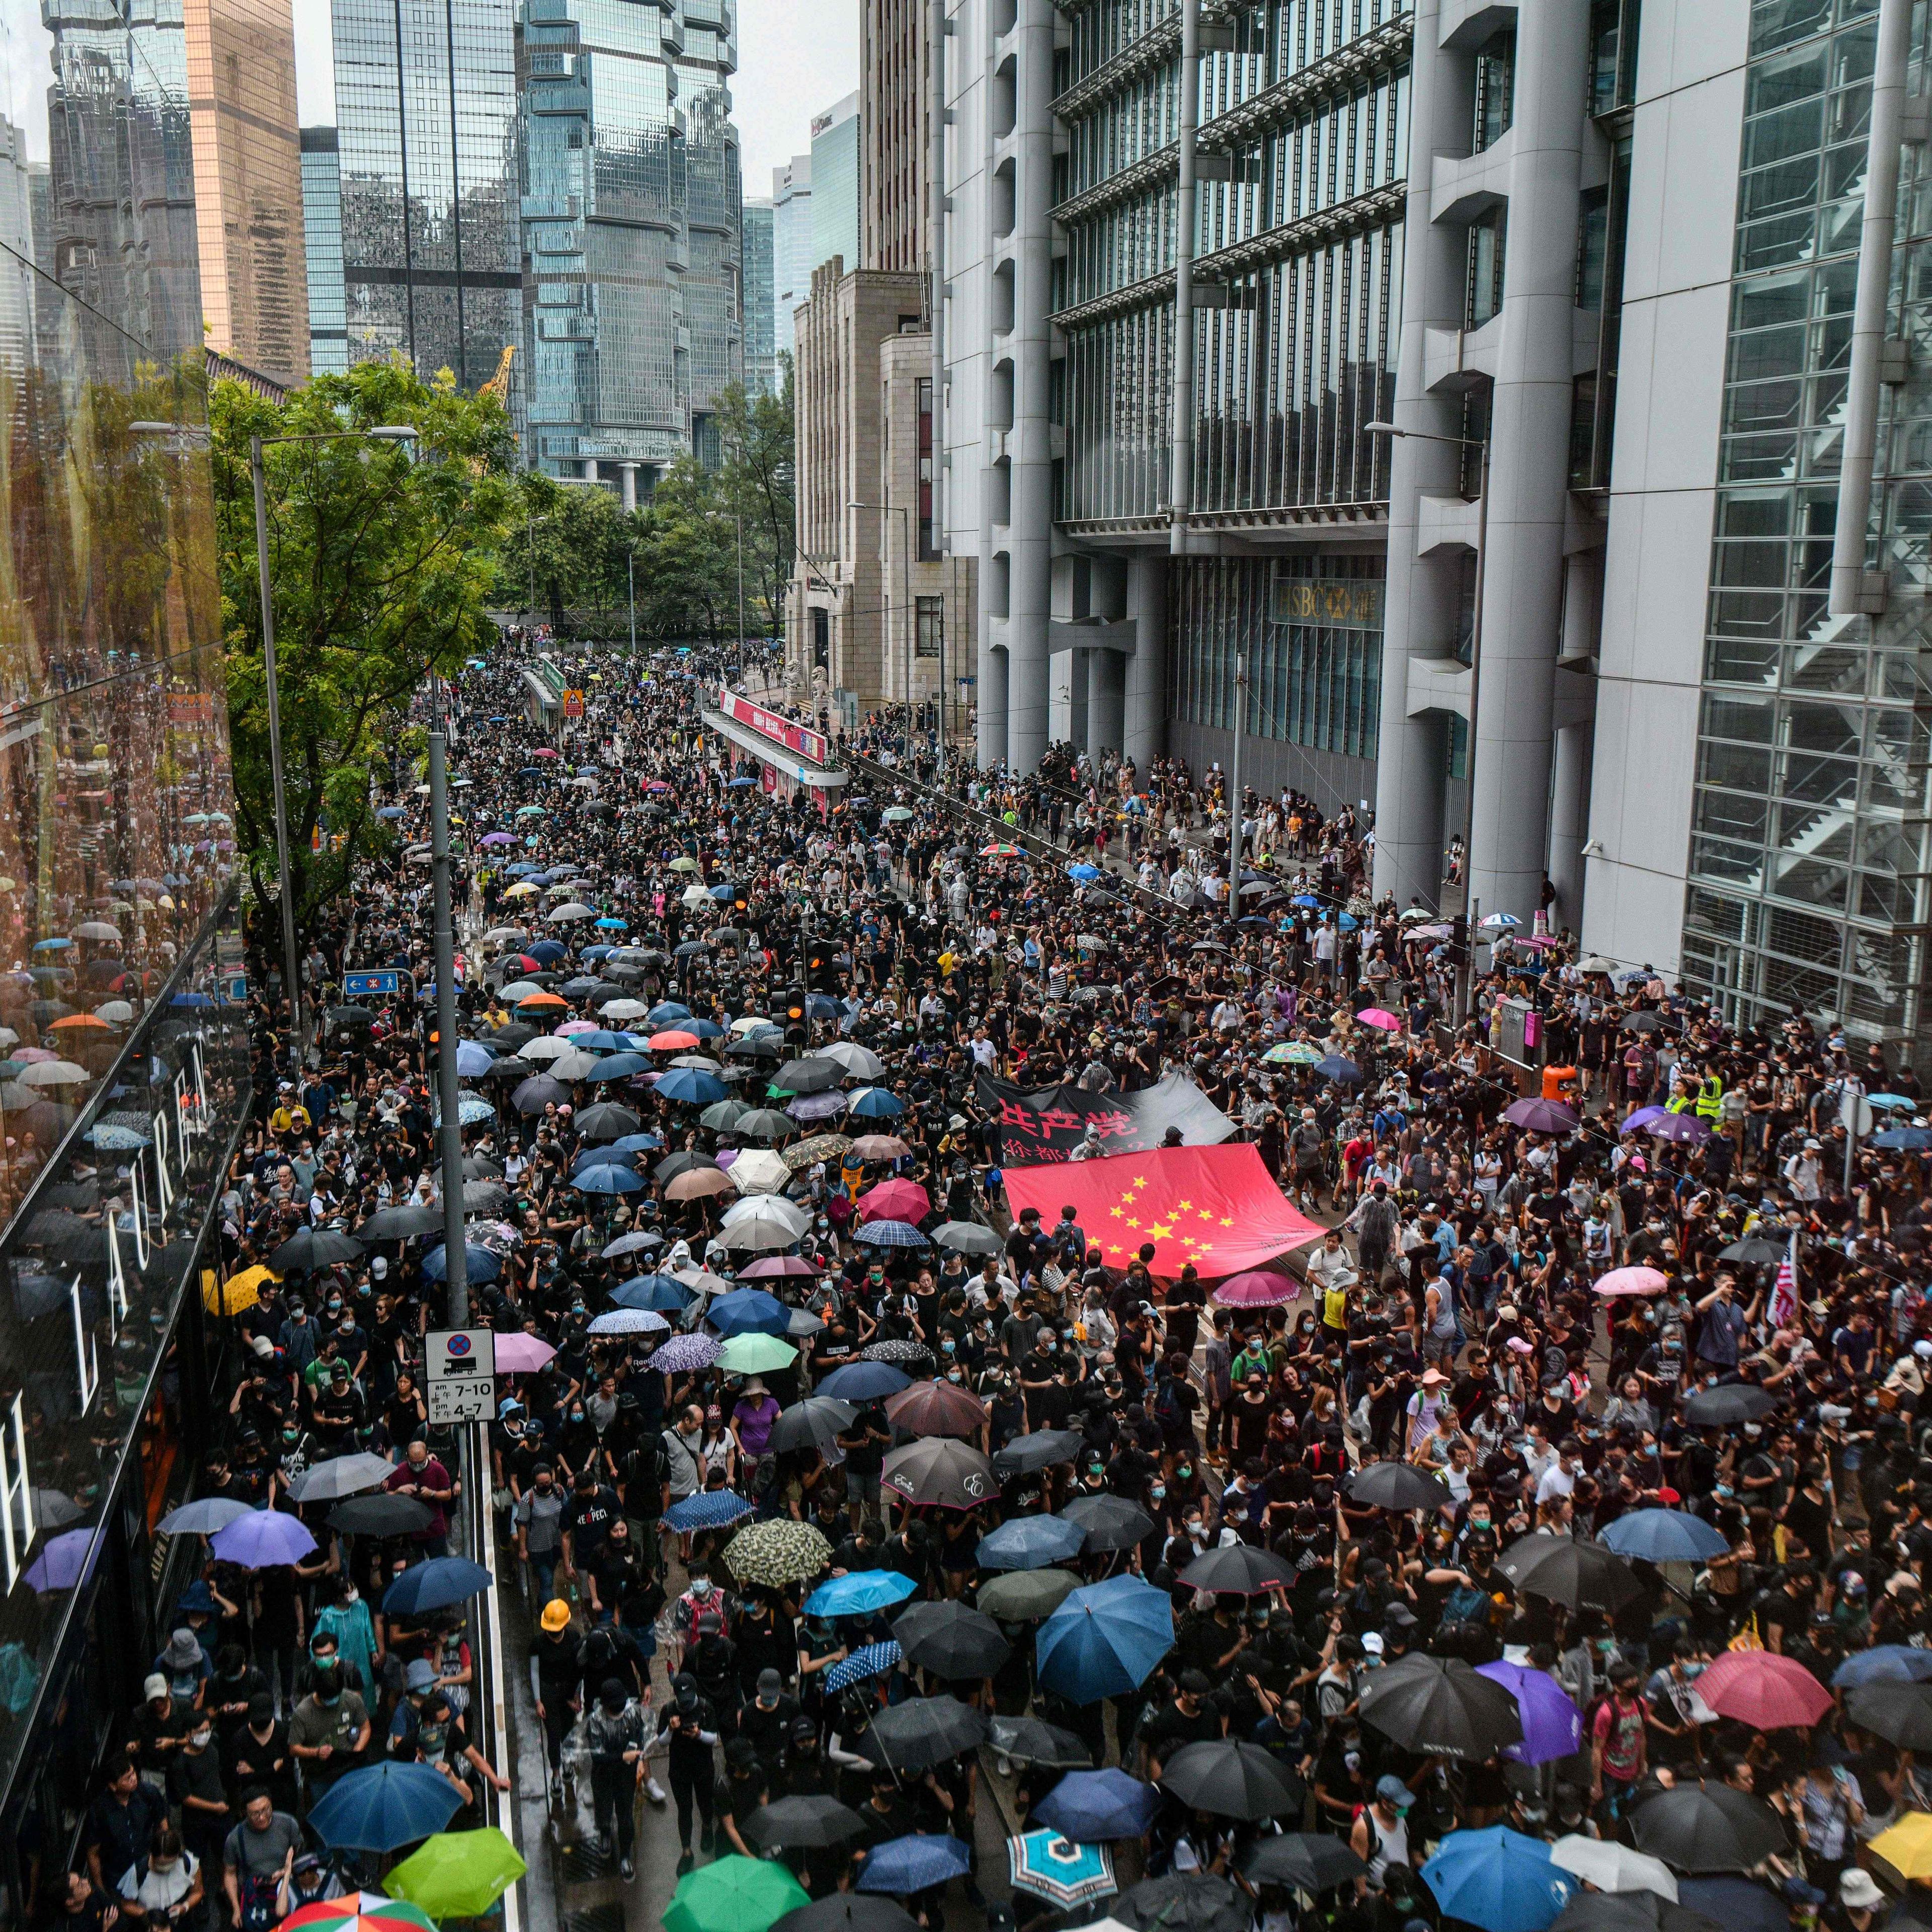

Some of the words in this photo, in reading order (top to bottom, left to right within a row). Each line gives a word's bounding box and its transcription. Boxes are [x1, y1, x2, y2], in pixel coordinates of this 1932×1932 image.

[1279, 586, 1324, 618] HSBC
[999, 1098, 1139, 1140] 共产党
[455, 1383, 491, 1397] 7-10
[454, 1403, 482, 1416] 4-7
